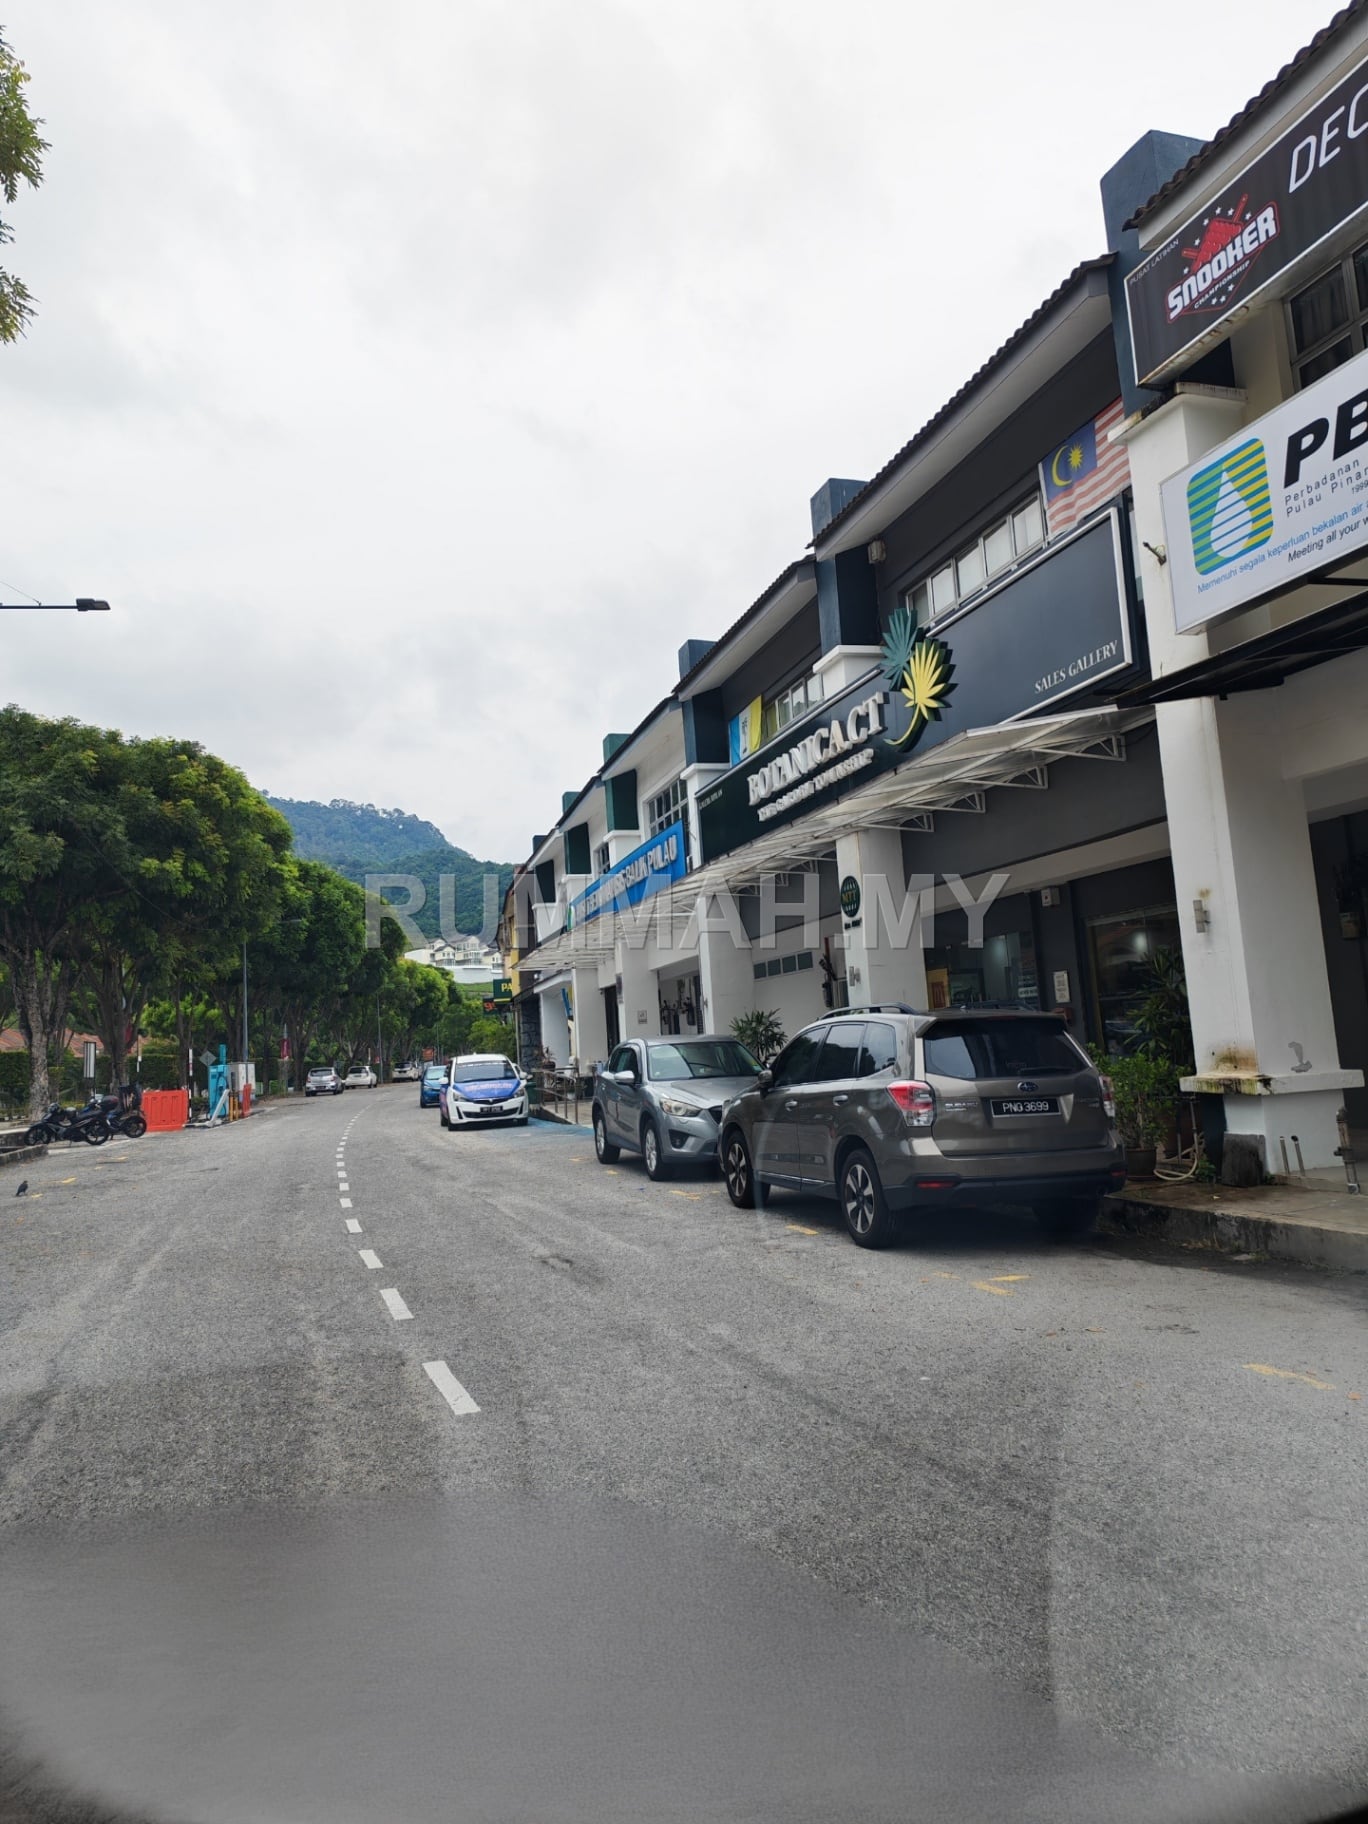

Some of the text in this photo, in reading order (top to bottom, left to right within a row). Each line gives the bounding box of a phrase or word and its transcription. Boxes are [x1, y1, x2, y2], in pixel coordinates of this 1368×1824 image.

[1168, 206, 1277, 320] SNOOKER
[1194, 260, 1250, 309] CHAMPIONSHIP
[1284, 459, 1360, 506] Perbadanan
[1286, 493, 1322, 518] Pulau
[1197, 502, 1364, 594] Memenuhi segala keperluan bekalan air
[1288, 538, 1324, 563] Meeting
[1325, 529, 1337, 544] all
[1339, 519, 1360, 541] your
[1034, 640, 1118, 695] SALES GALLERY
[647, 834, 678, 873] PULAU
[1025, 1101, 1049, 1112] 3699
